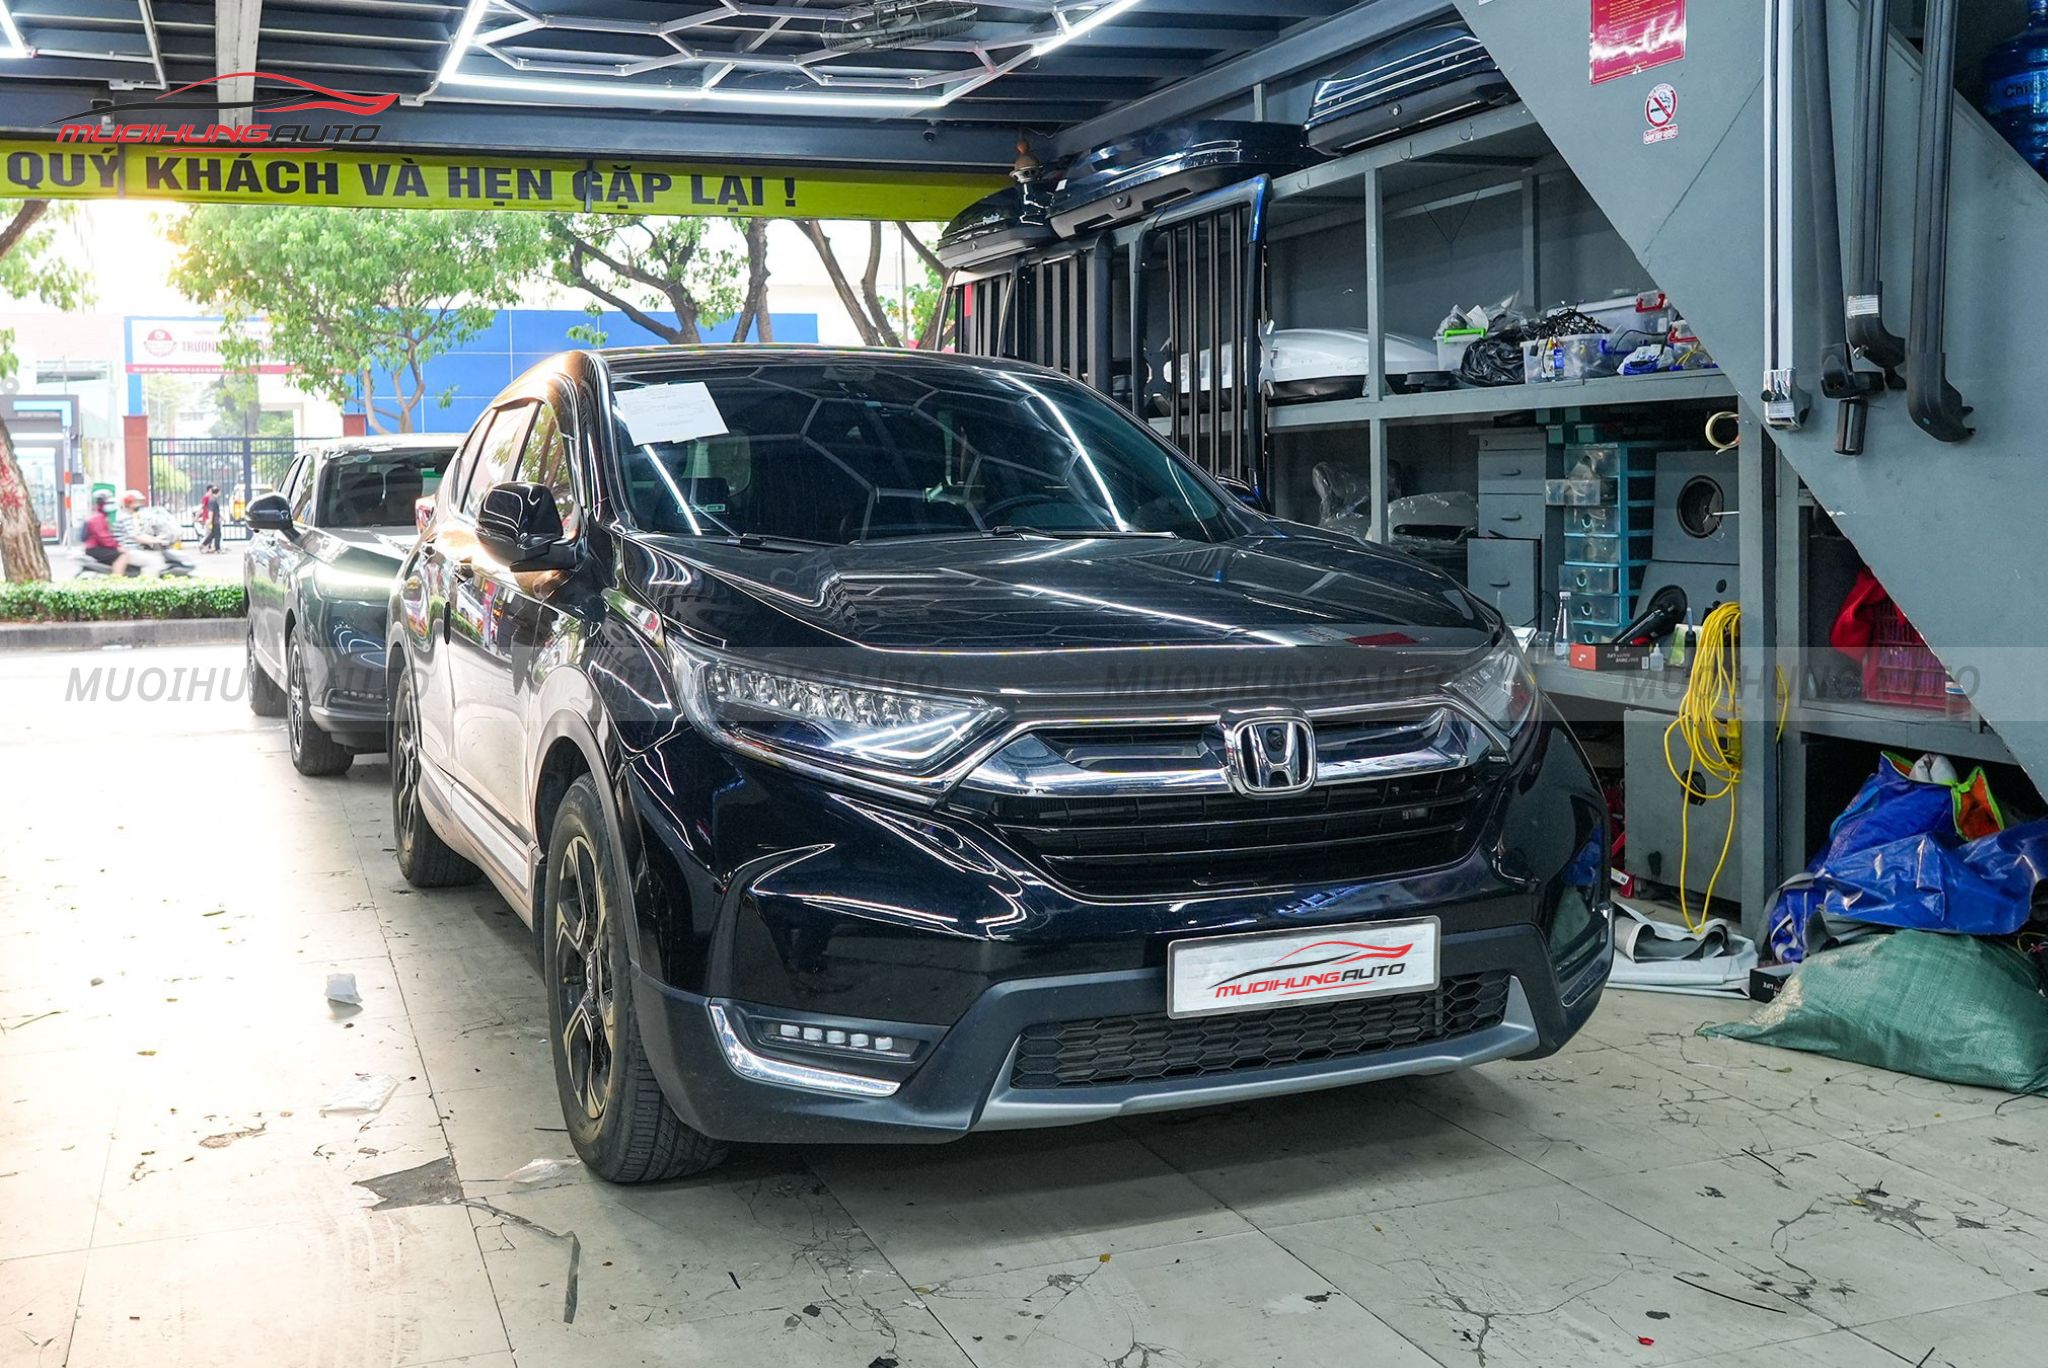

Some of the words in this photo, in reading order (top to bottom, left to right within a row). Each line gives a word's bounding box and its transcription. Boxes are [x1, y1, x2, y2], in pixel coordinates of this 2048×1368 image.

[7, 147, 119, 188] QUÝ
[146, 153, 339, 195] KHÁCH
[358, 157, 429, 197] VÀ
[448, 166, 553, 207] HẸN
[572, 165, 672, 210] GẶP
[691, 174, 763, 213] LẠI
[1215, 963, 1406, 998] MUOIHUNGAUTO
